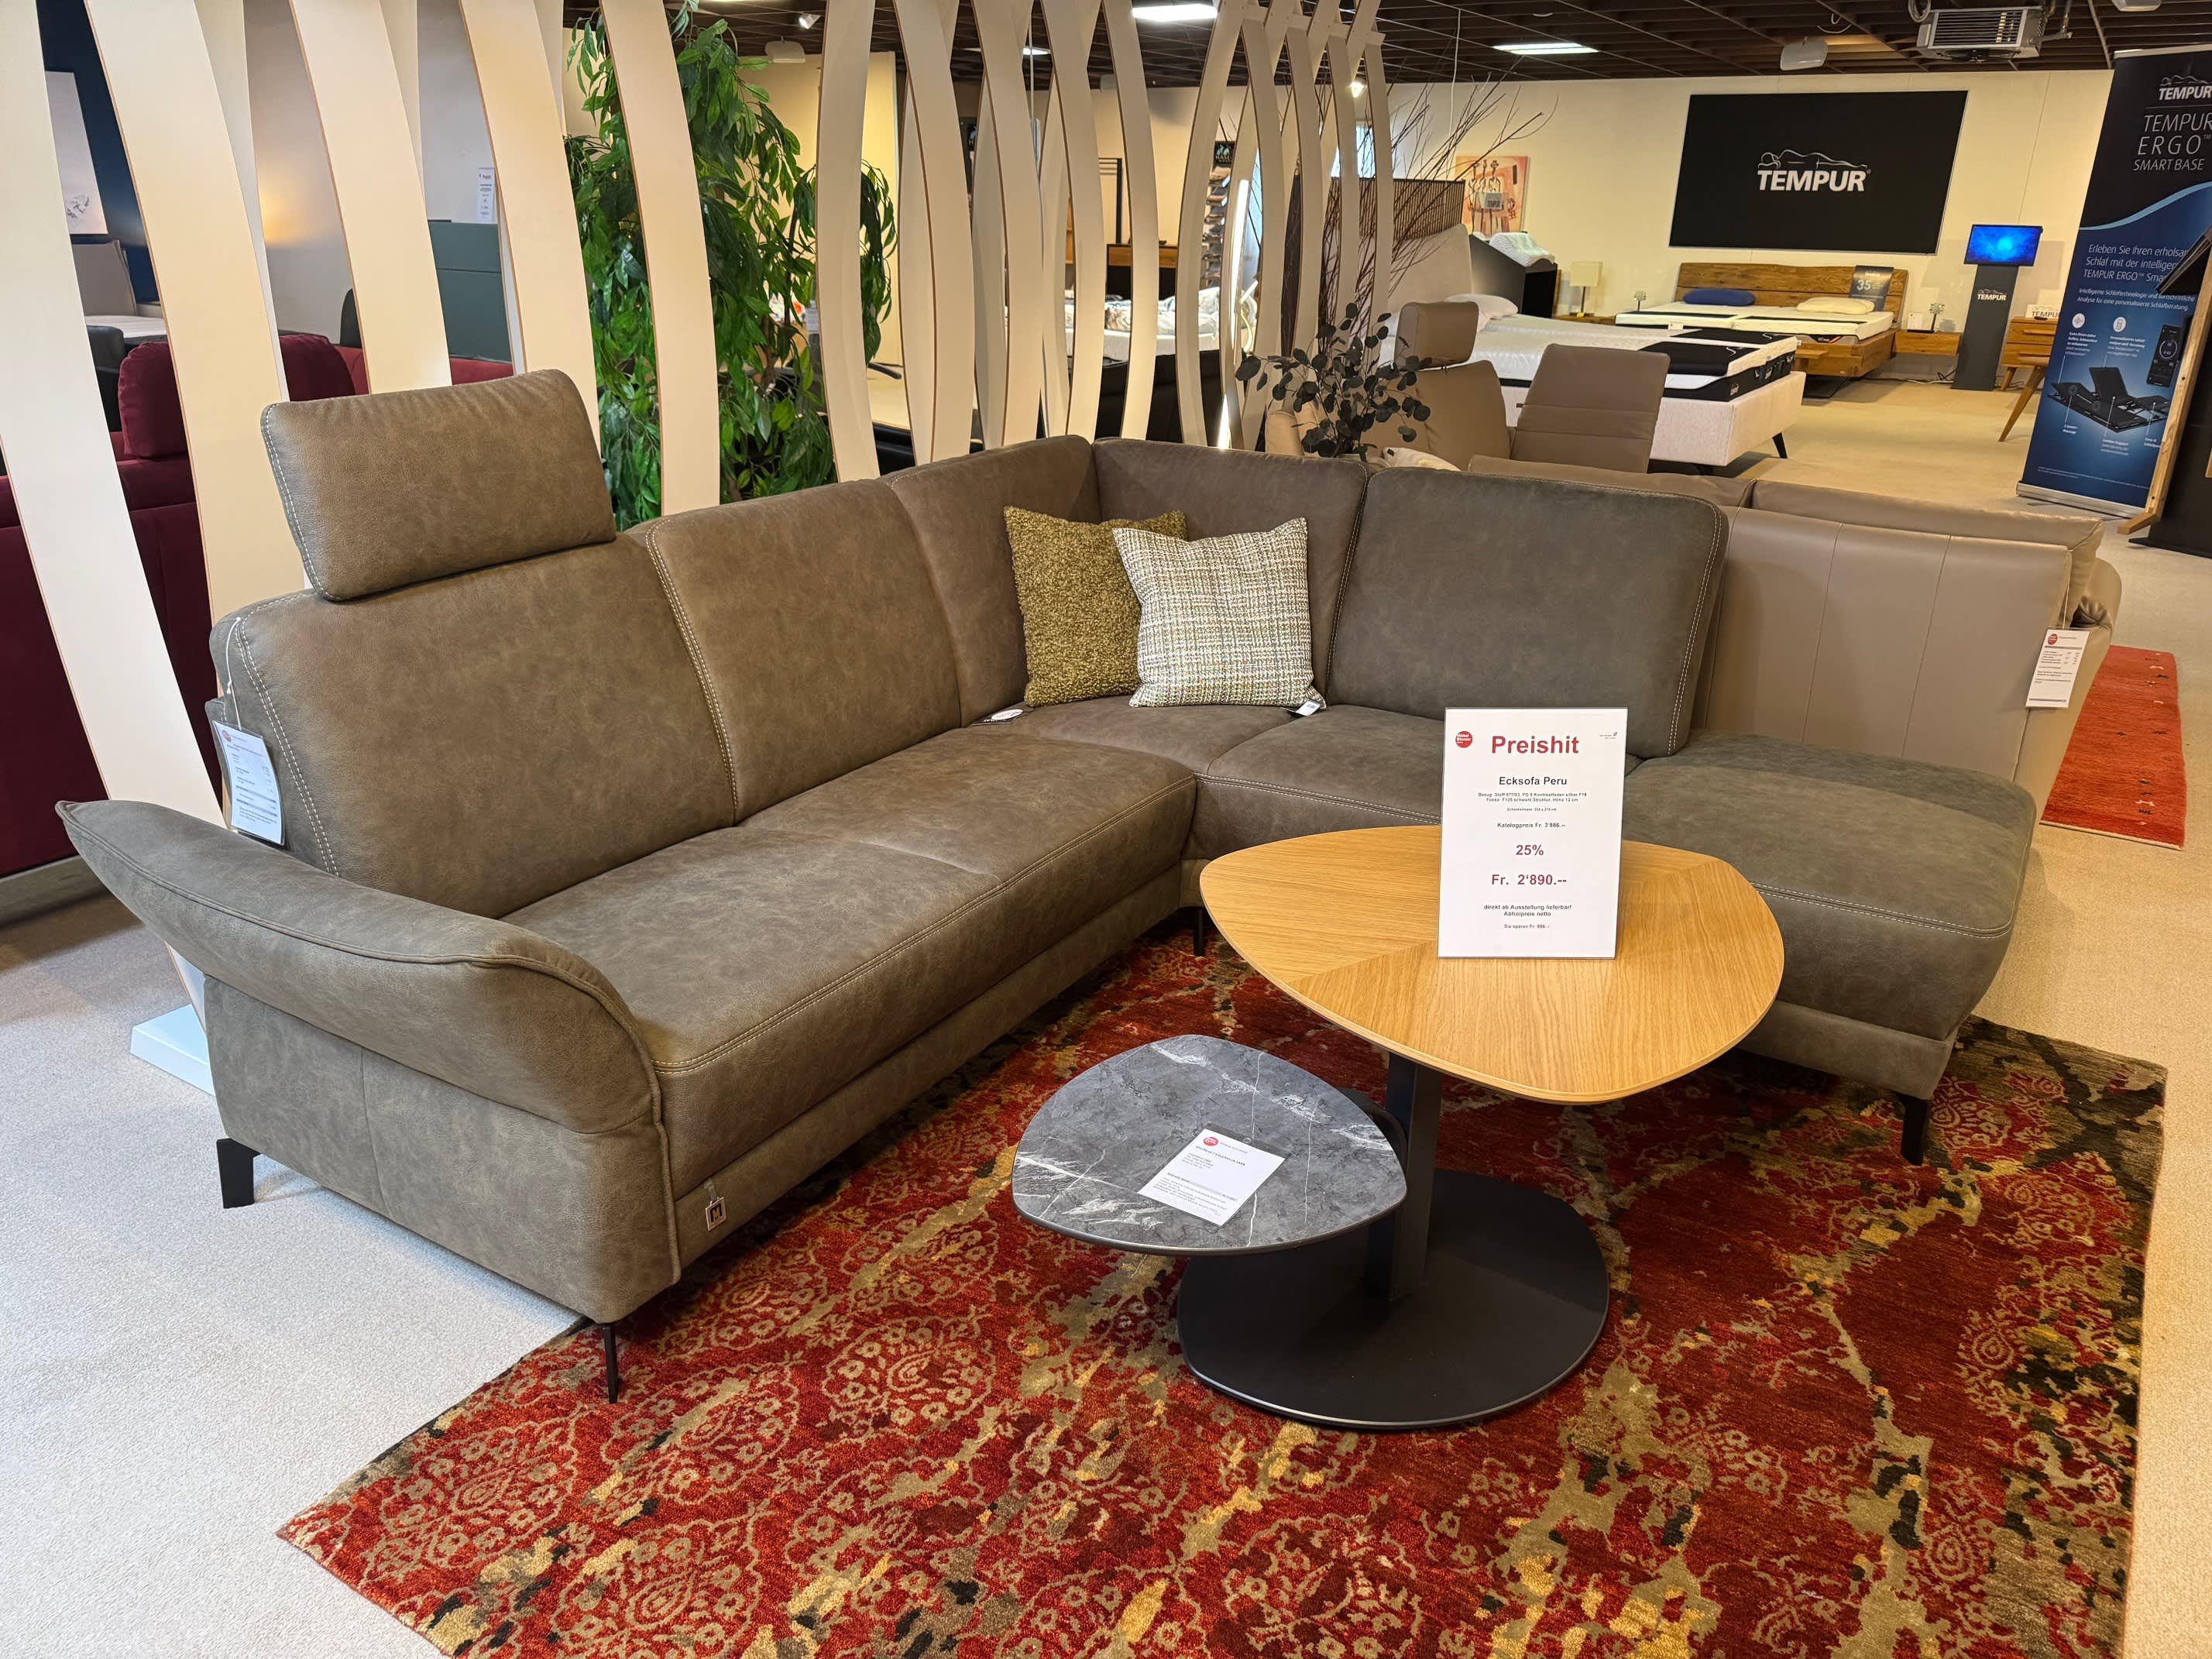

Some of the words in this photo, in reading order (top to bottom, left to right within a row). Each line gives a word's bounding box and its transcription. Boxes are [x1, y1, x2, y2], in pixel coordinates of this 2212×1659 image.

[2159, 85, 2212, 101] TEMPUR
[2144, 112, 2212, 132] TEMPUR
[1757, 169, 1867, 192] TEMPUR
[2088, 244, 2117, 254] Erleben
[2119, 246, 2131, 255] Sie
[2131, 246, 2152, 256] Ihren
[2086, 256, 2108, 266] Schlaf
[2111, 258, 2123, 267] mit
[2125, 259, 2138, 268] der
[2083, 269, 2114, 280] TEMPUR
[1856, 280, 1871, 290] 35
[1492, 735, 1579, 754] Preishit
[1499, 776, 1540, 785] Ecksofa
[1544, 776, 1568, 785] Peru
[1516, 844, 1544, 856] 25%
[1492, 874, 1509, 885] Fr.
